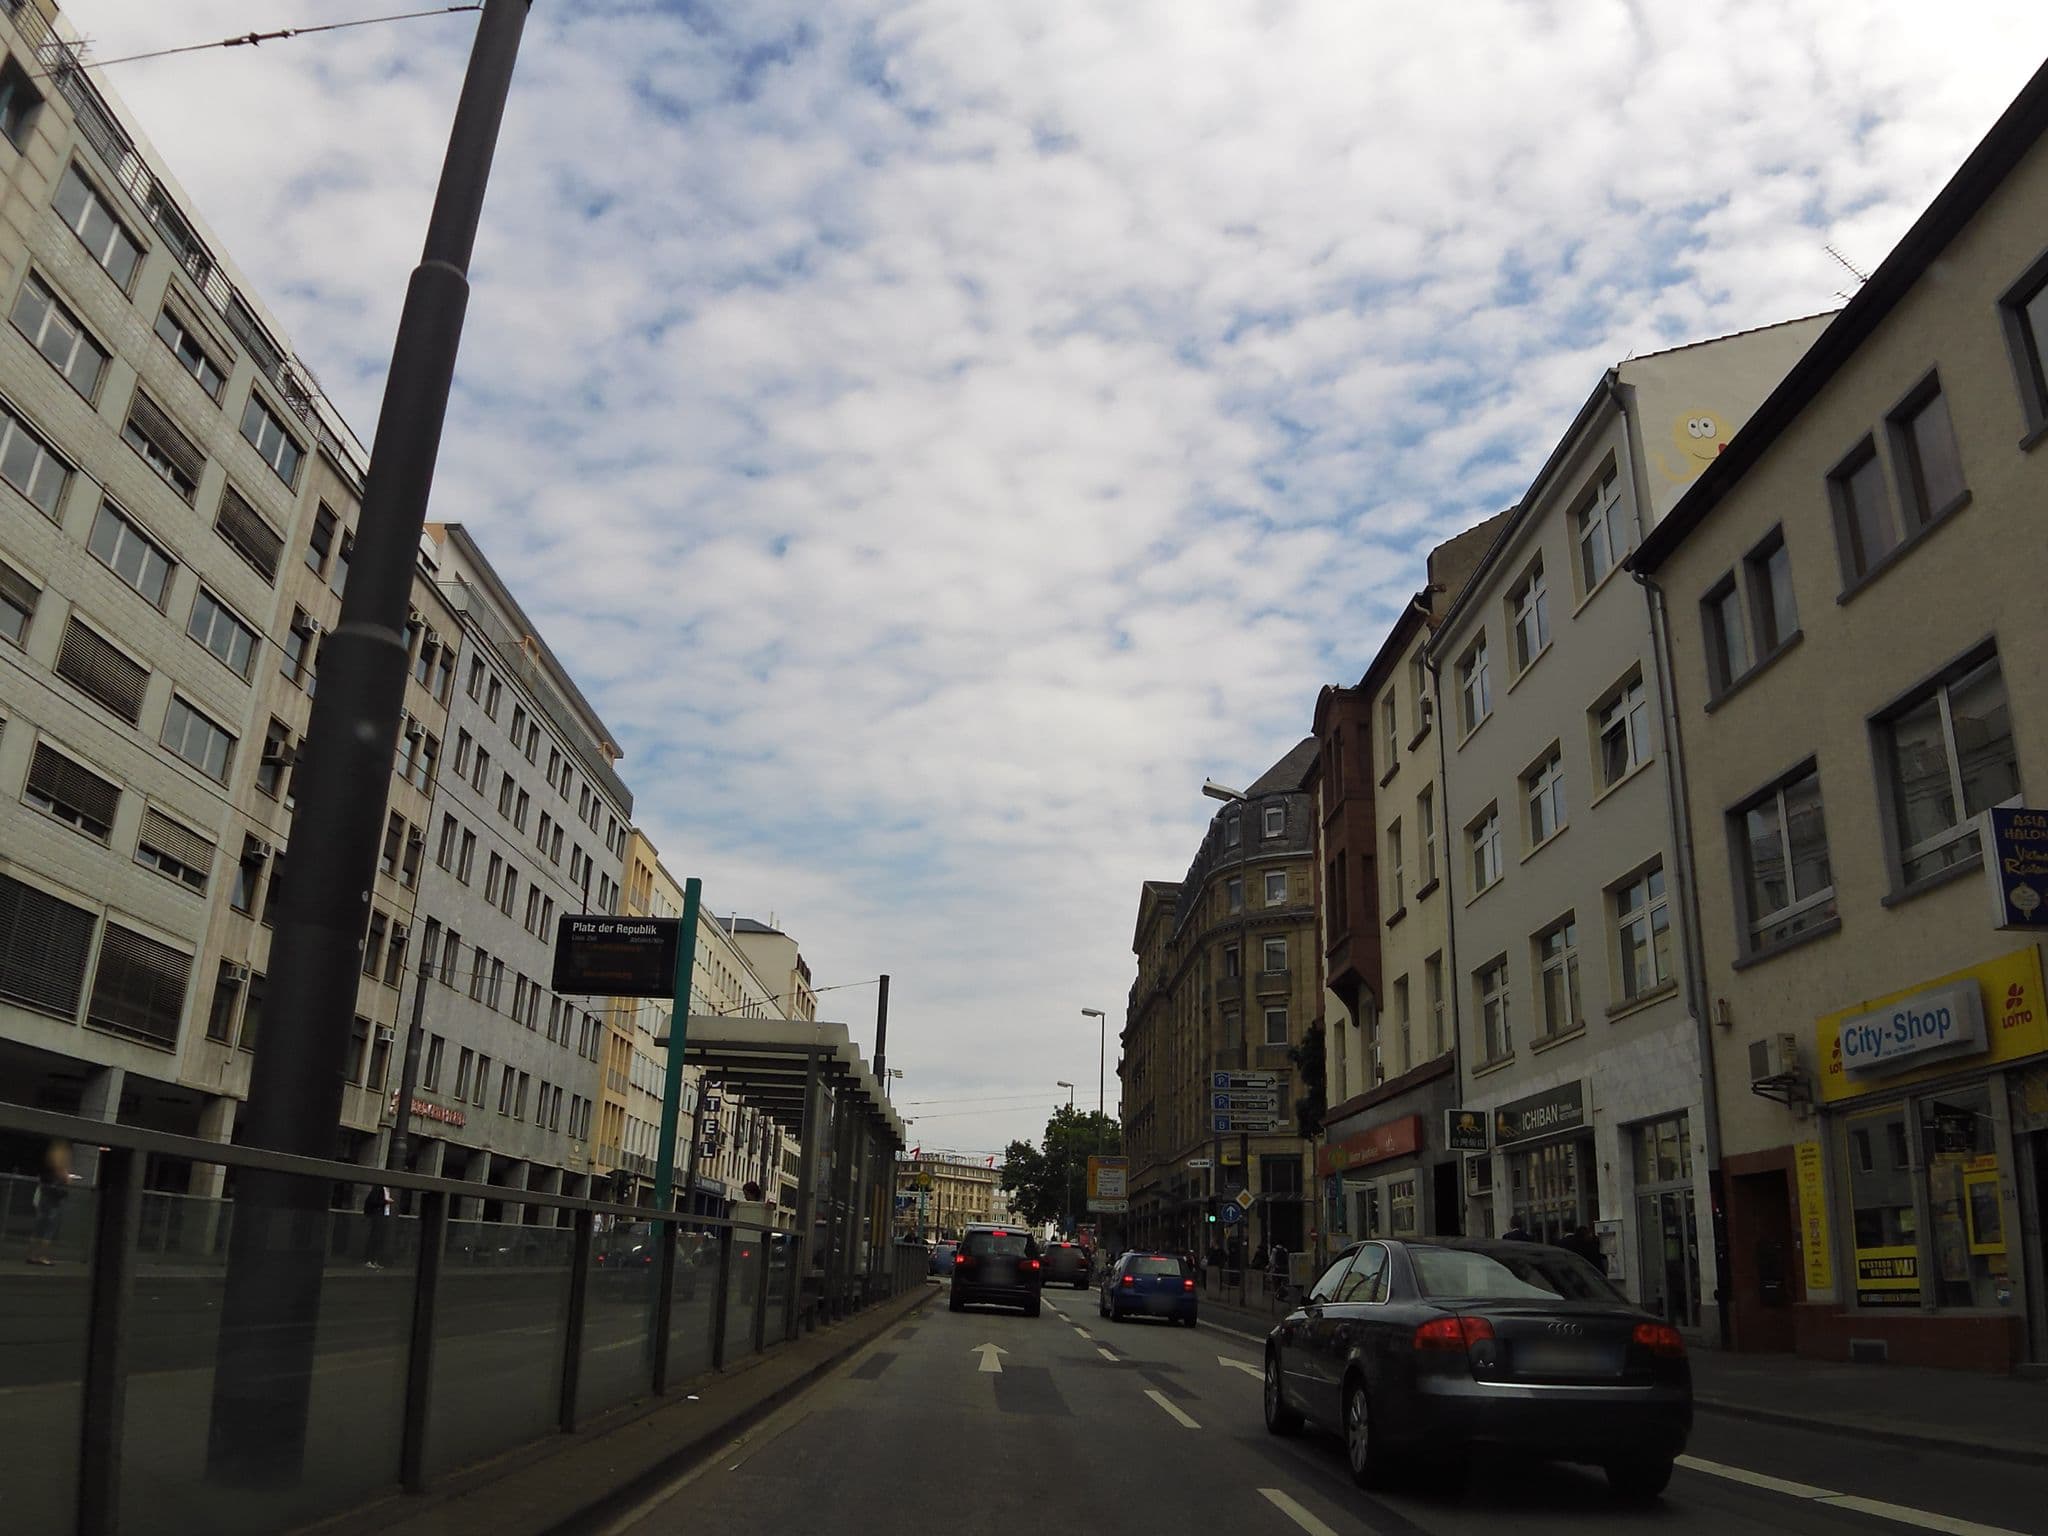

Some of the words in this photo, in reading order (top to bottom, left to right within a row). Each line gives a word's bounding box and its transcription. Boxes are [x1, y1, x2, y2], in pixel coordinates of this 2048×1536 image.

[572, 921, 596, 933] Platz
[598, 922, 614, 934] der
[616, 923, 657, 936] Republik
[2002, 1010, 2033, 1029] LOTTO
[1844, 1006, 1952, 1058] City-Shop
[1522, 1103, 1559, 1132] ICHIBAN
